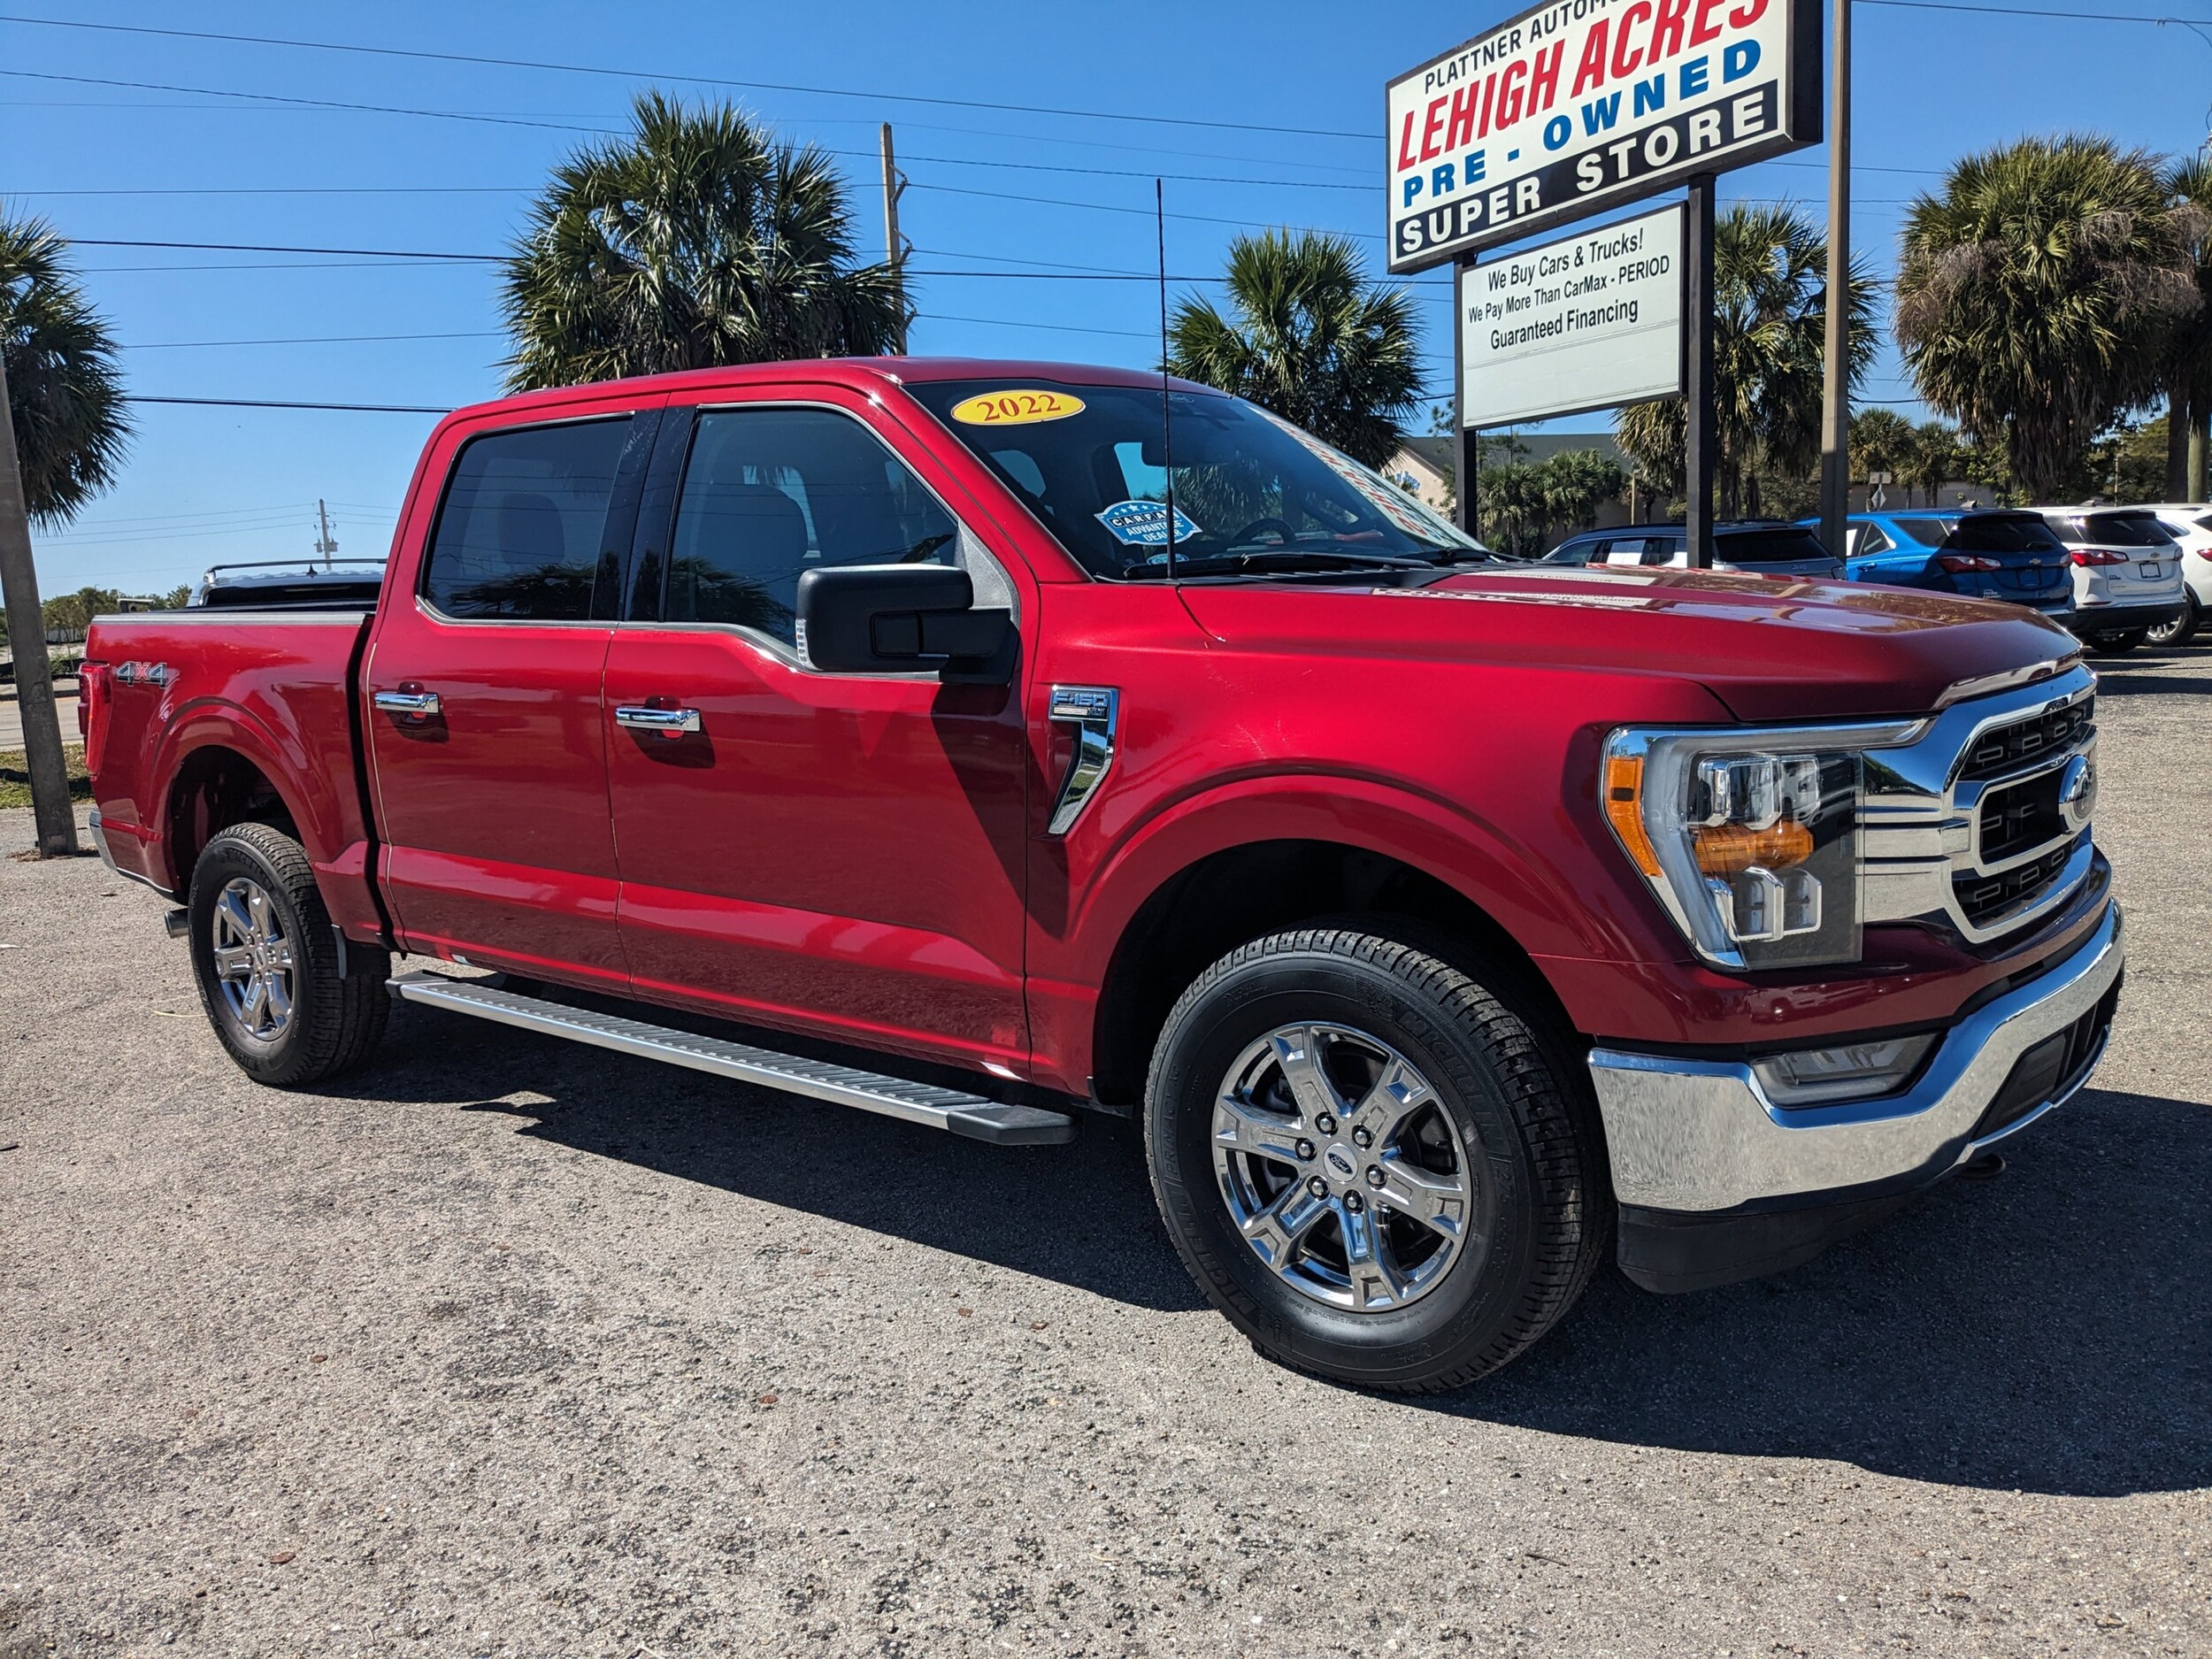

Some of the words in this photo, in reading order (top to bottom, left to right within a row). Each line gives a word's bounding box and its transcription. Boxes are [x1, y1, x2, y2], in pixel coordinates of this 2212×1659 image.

[1425, 28, 1522, 95] PLATTNER
[1529, 0, 1617, 43] AUTO
[1397, 38, 1566, 173] LEHIGH
[1403, 149, 1486, 209] PRE
[1543, 38, 1762, 151] OWNED
[1402, 176, 1541, 252] SUPER
[1576, 90, 1765, 193] STORE
[1468, 306, 1483, 324] We
[1485, 302, 1503, 320] Pay
[1506, 294, 1532, 314] More
[1533, 285, 1561, 307] Than
[1563, 273, 1608, 299] CarMax
[1617, 255, 1671, 285] PERIOD
[1487, 270, 1507, 293] We
[1509, 264, 1536, 288] Buy
[1539, 256, 1570, 278] Cars
[1573, 245, 1585, 268] &
[1588, 227, 1644, 265] Trucks!
[1490, 312, 1563, 350] Guaranteed
[1566, 298, 1639, 332] Financing
[976, 394, 1062, 422] 2022
[1087, 708, 1106, 717] XLT
[1398, 1010, 1508, 1146] MICHELIN
